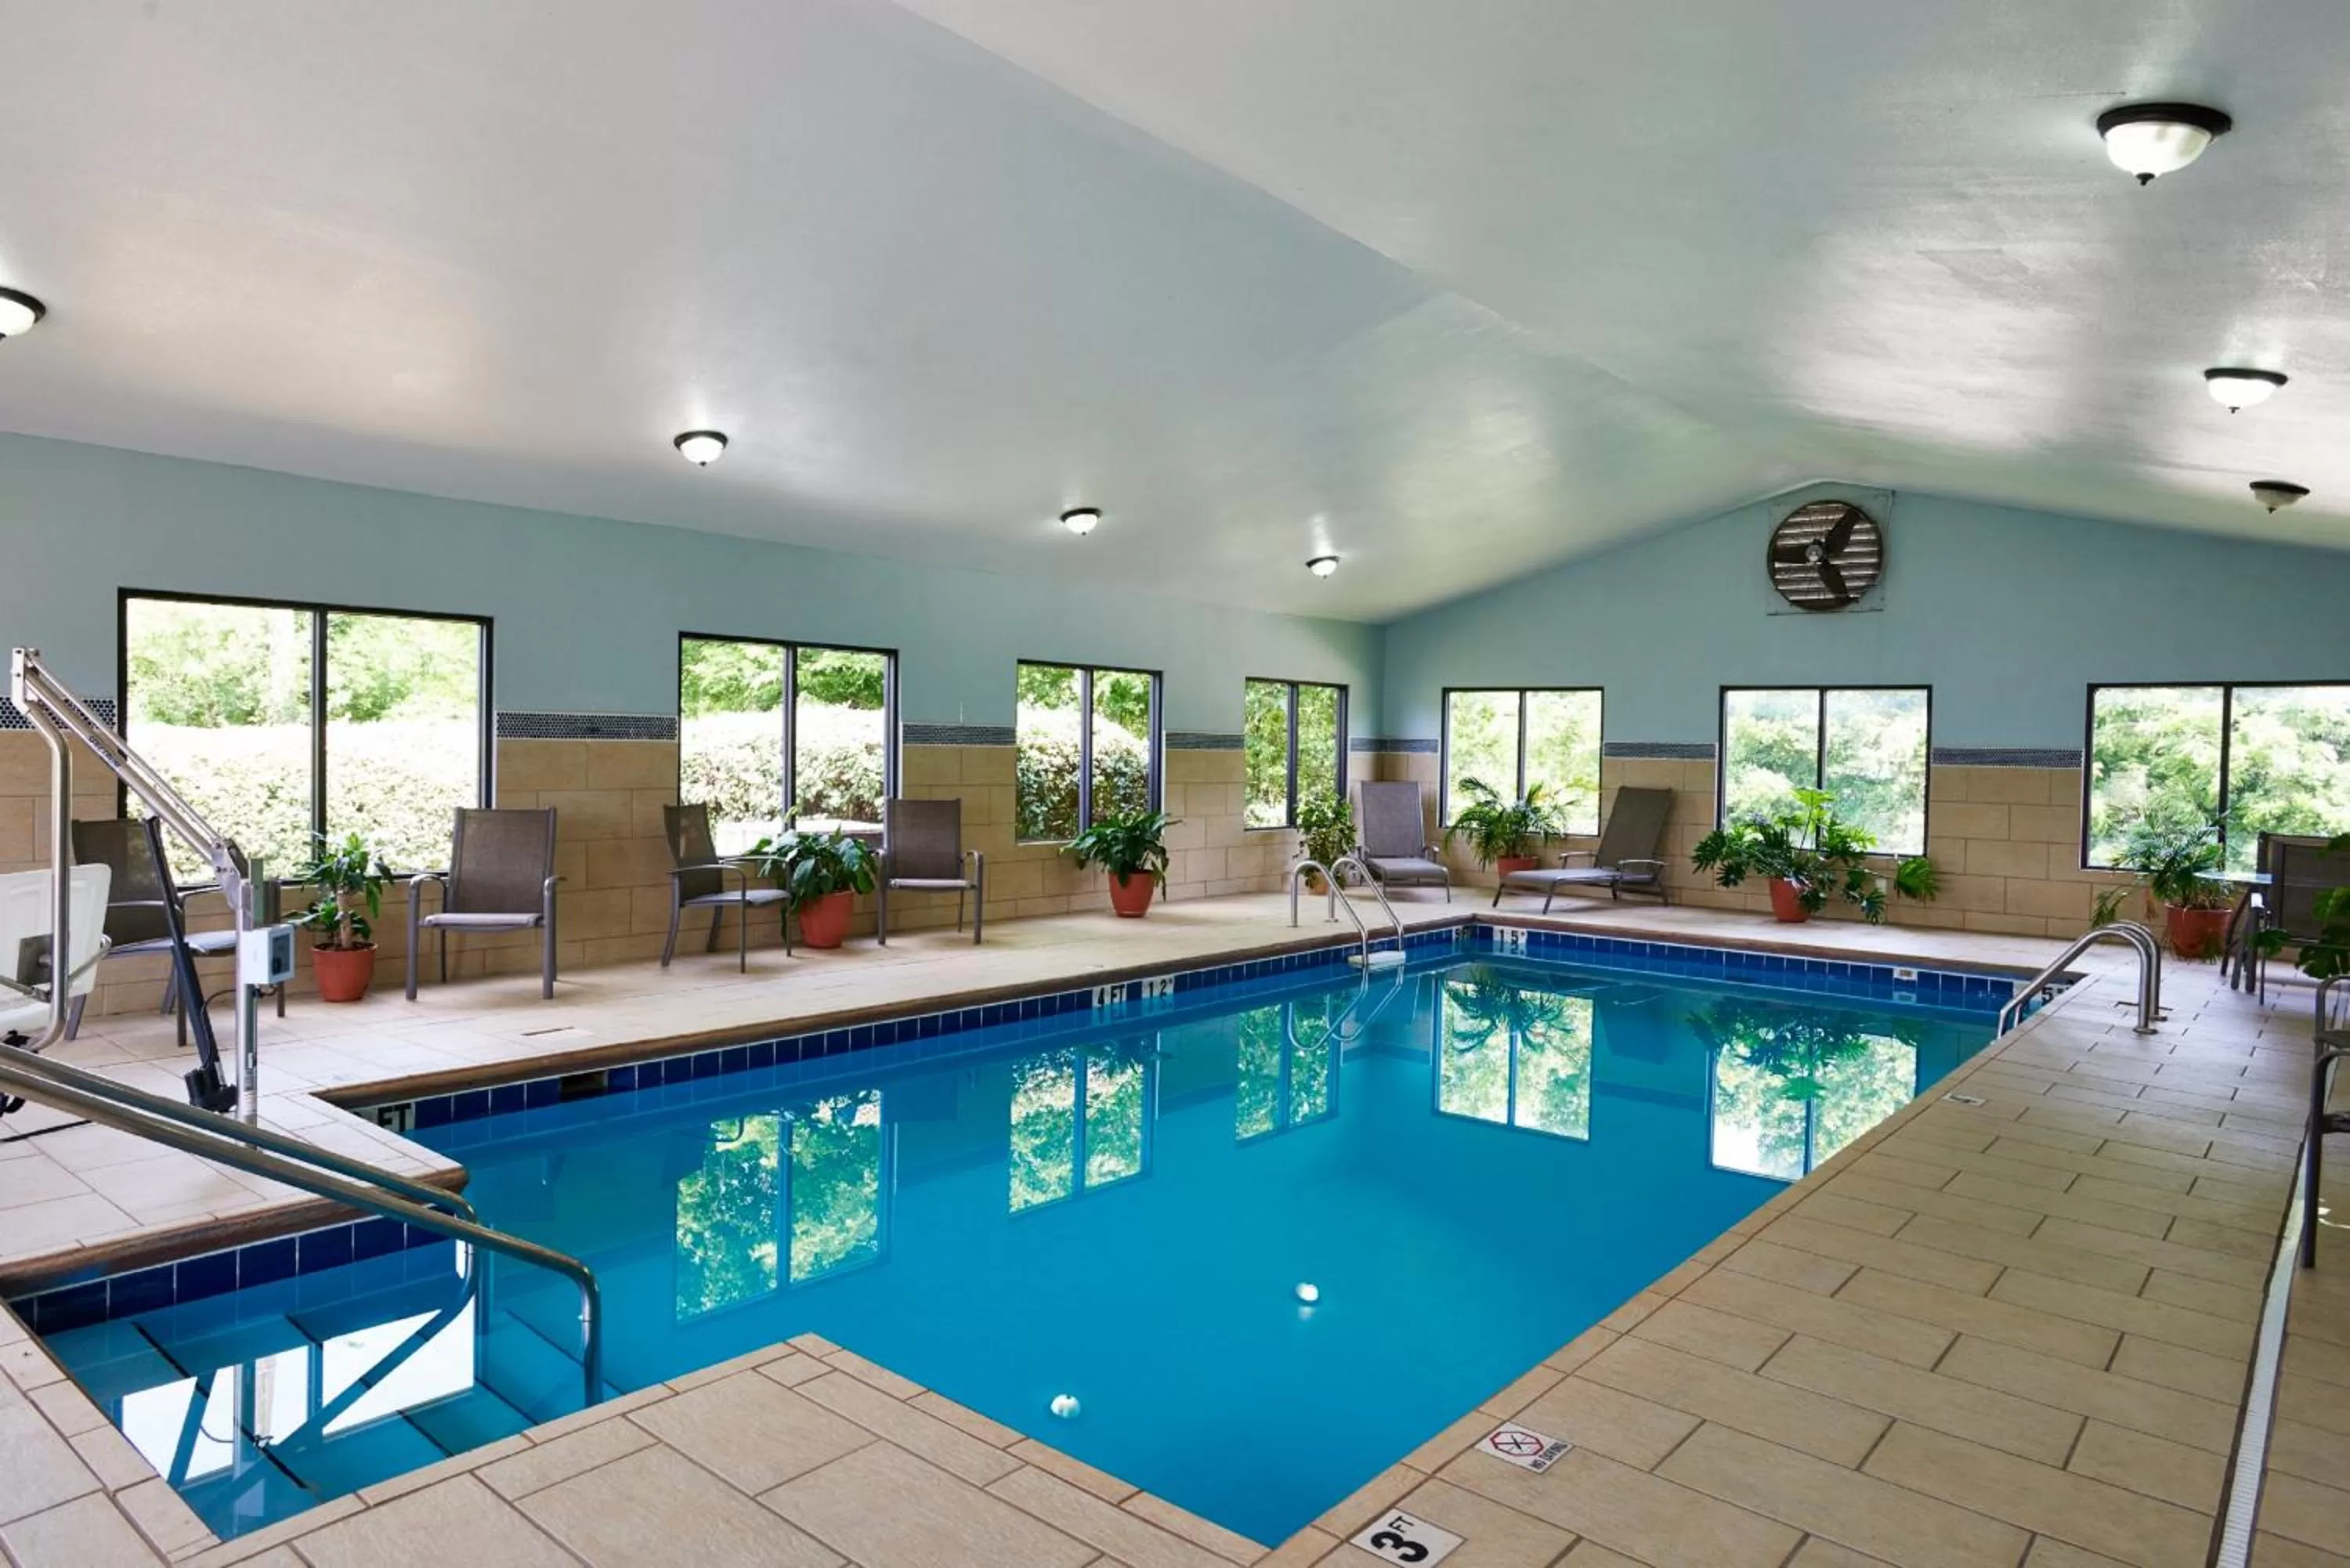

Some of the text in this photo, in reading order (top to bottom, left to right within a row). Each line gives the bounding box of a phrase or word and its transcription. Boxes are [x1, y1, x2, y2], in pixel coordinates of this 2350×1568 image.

[1111, 984, 1125, 1003] FT
[377, 1102, 412, 1133] FT
[1370, 1516, 1430, 1563] 3 FT
